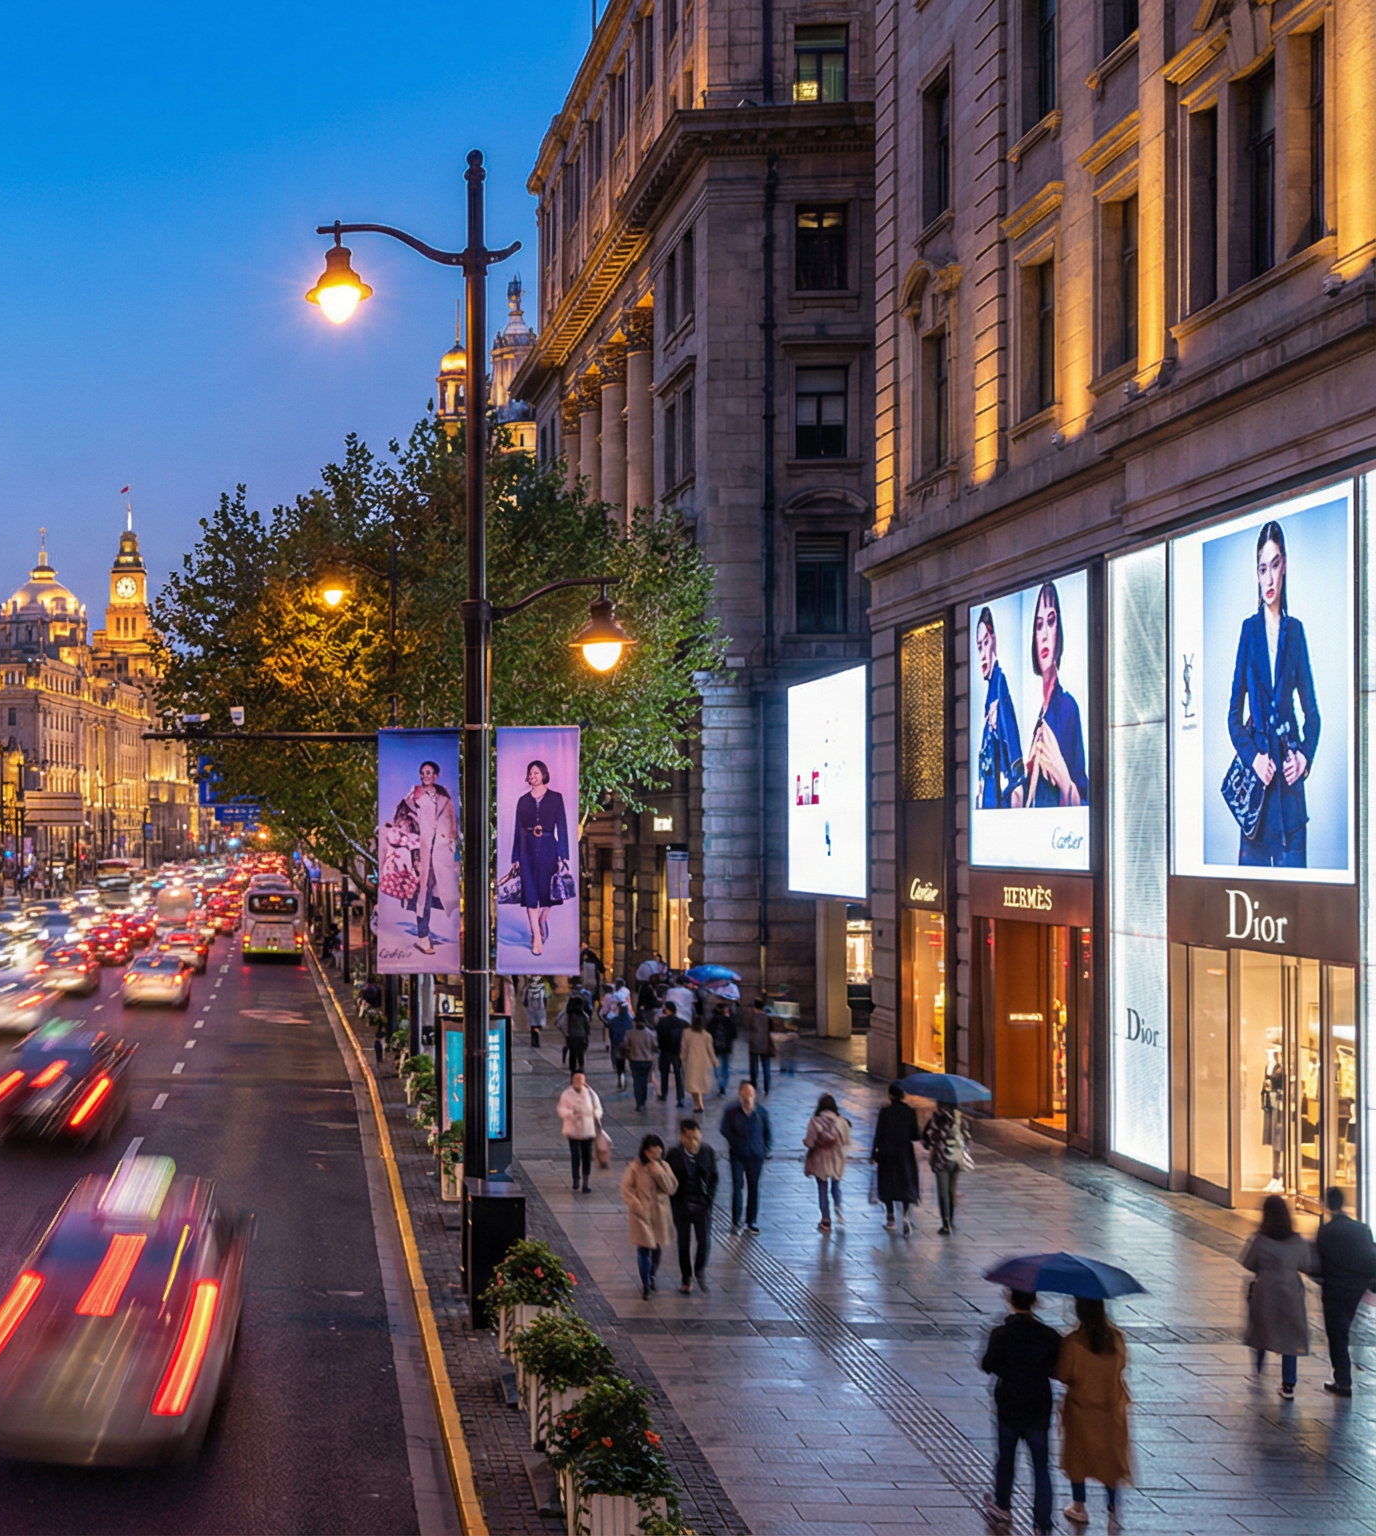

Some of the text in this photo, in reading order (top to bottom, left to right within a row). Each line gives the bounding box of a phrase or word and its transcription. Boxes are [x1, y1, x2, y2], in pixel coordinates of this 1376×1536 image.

[1003, 885, 1053, 910] HERMÈS
[1225, 889, 1288, 943] Dior
[1126, 1007, 1159, 1046] Dior
